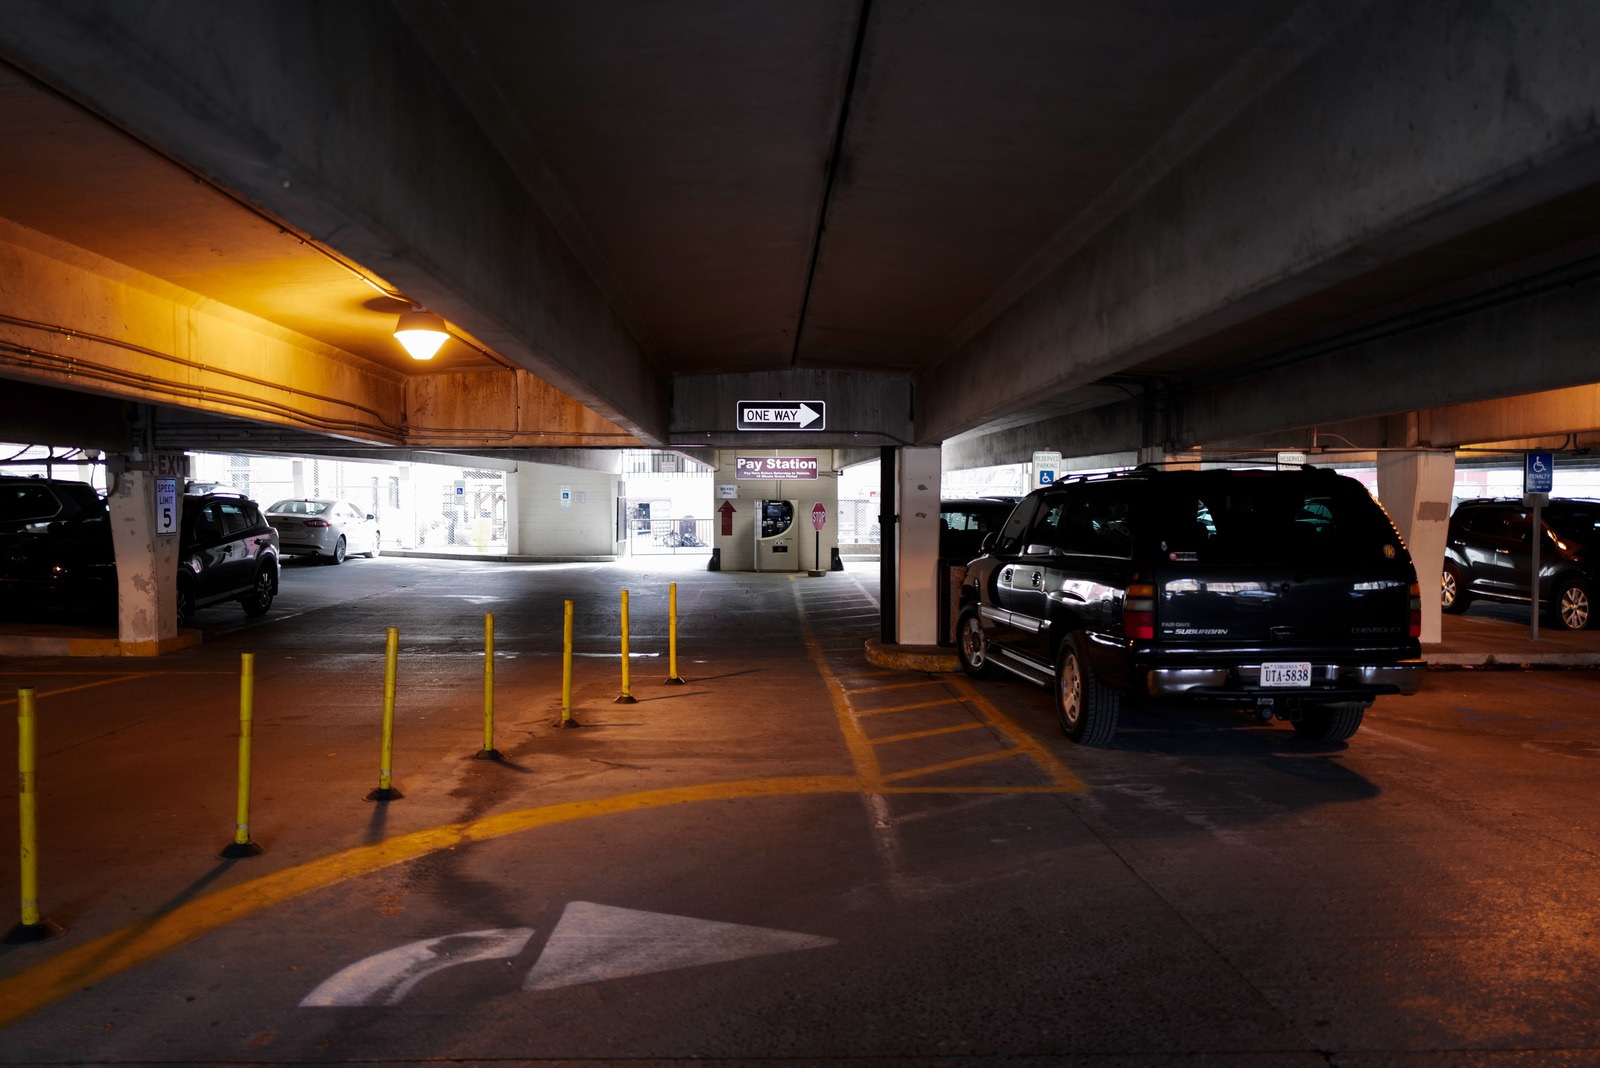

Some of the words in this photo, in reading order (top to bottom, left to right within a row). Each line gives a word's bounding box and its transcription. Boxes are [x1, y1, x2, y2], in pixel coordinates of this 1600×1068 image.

[747, 410, 770, 420] ONE
[774, 410, 798, 421] WAY
[158, 454, 188, 475] EXIT
[737, 458, 763, 471] Pay
[766, 458, 817, 469] Station
[158, 484, 175, 492] SPEED
[163, 507, 172, 528] 5
[812, 512, 825, 523] STOP
